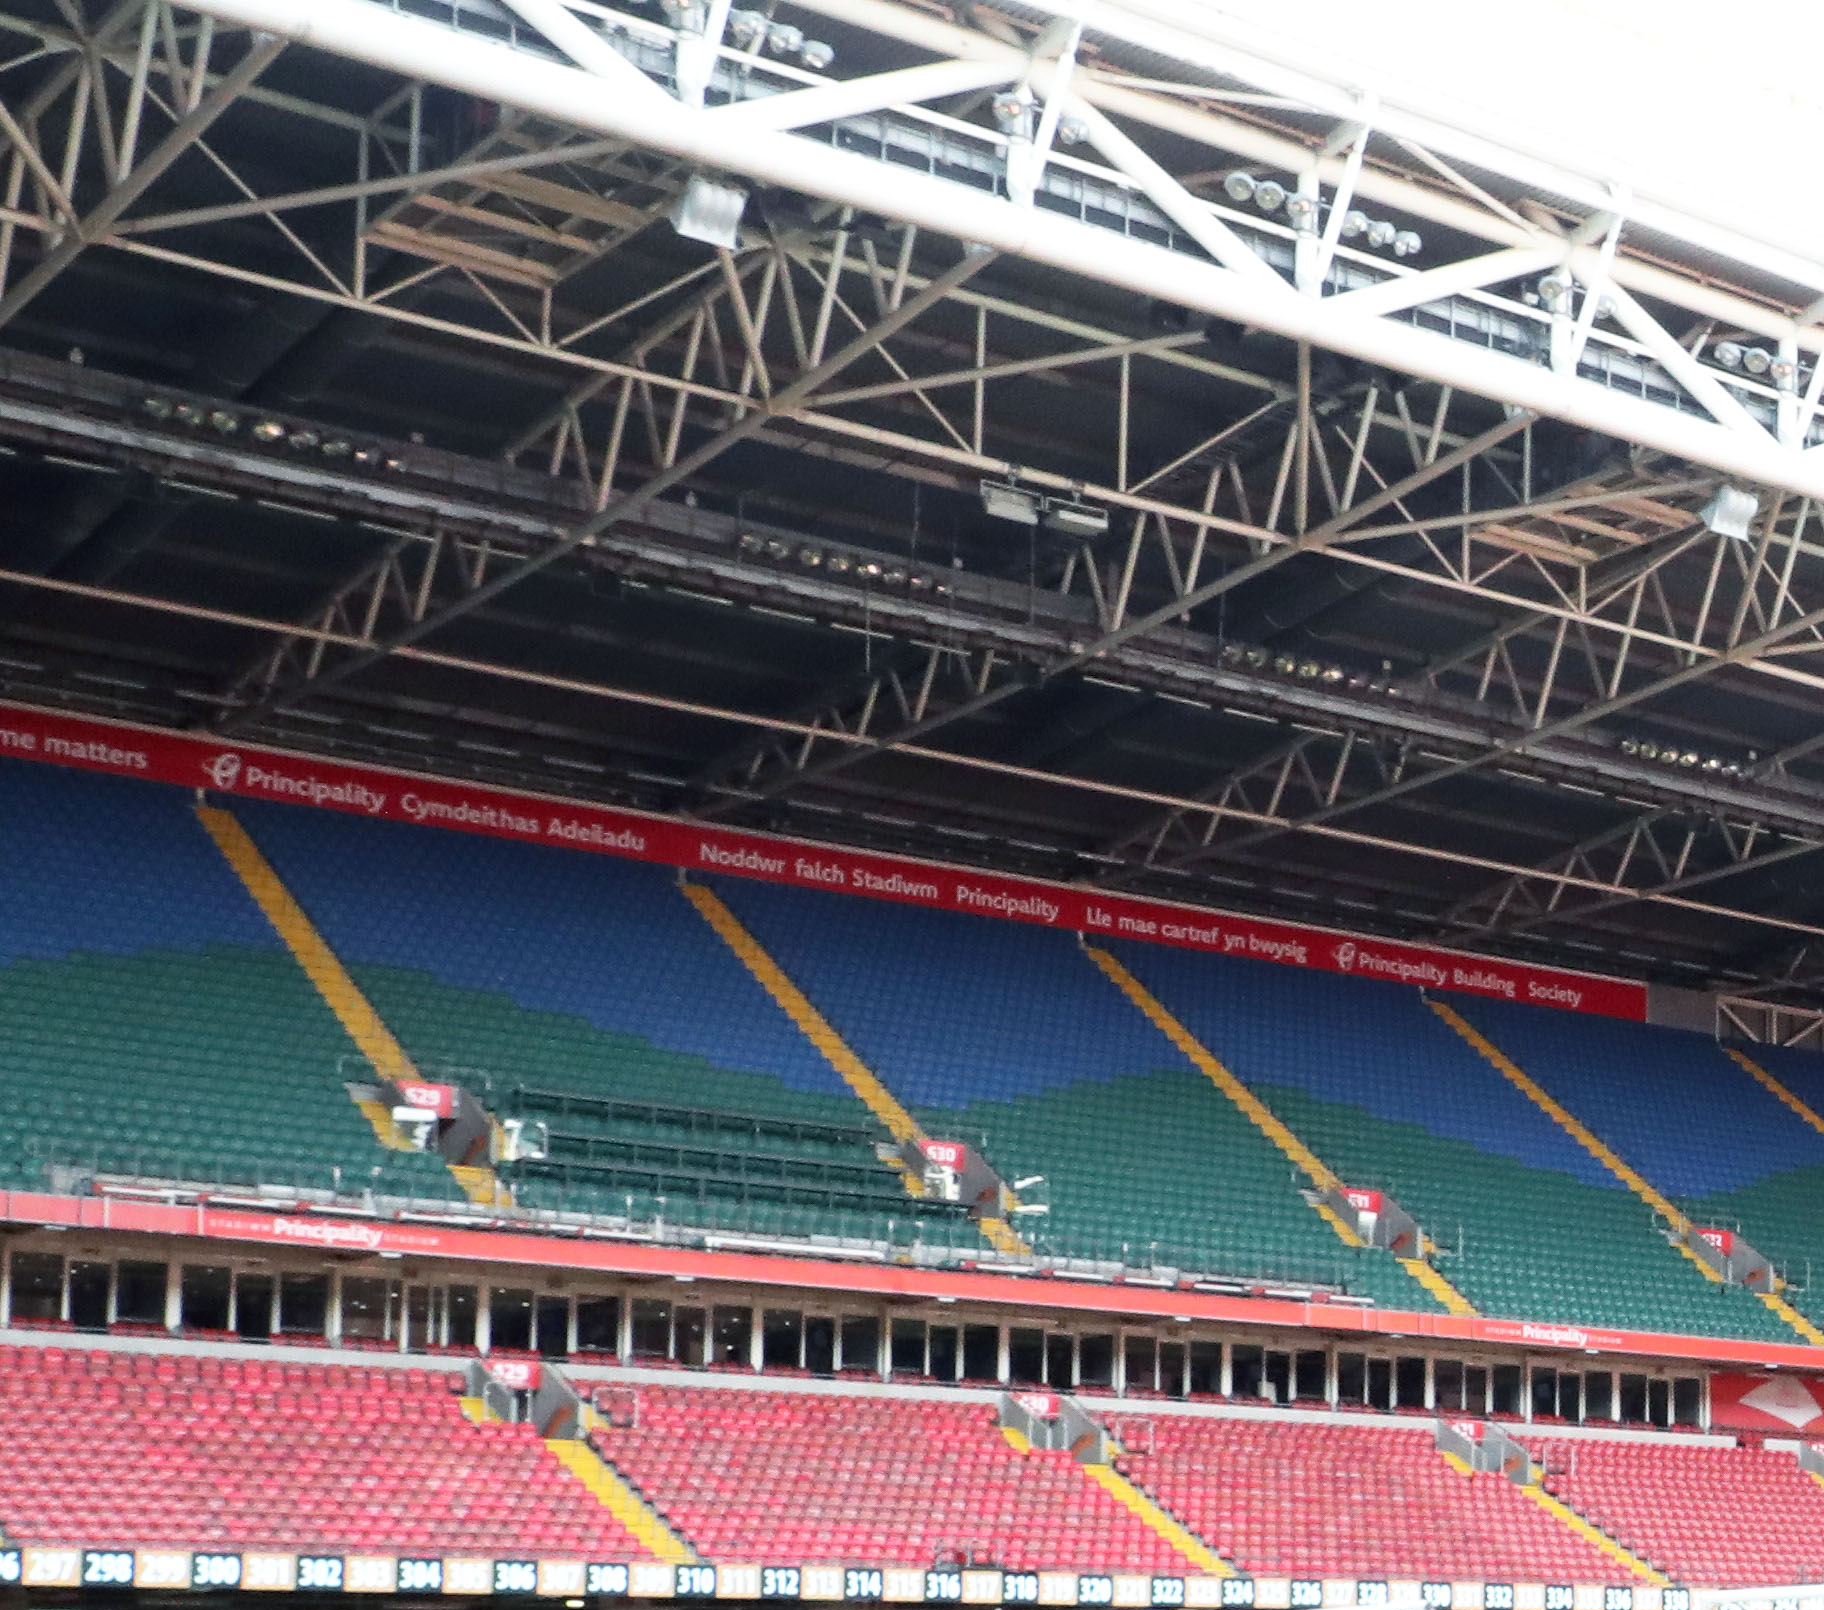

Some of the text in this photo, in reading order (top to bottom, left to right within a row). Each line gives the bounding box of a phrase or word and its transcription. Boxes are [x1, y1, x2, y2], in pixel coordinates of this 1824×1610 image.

[44, 736, 148, 769] matters
[246, 765, 647, 852] Principality Cymdeithas Adeiladu
[700, 844, 1060, 923] Noddwr falch Stadiwm Principality
[1086, 905, 1309, 965] Lle mae cartref yn bwysig
[1358, 952, 1583, 1008] Principality Building Society
[273, 1217, 384, 1249] Principality
[1522, 1324, 1588, 1347] Principality
[85, 1554, 132, 1582] 298
[194, 1556, 239, 1584] 300
[299, 1559, 341, 1586] 302
[399, 1561, 441, 1588] 304
[495, 1563, 535, 1589] 306
[588, 1566, 627, 1592] 308
[677, 1568, 714, 1593] 310
[722, 1569, 758, 1594] 311
[763, 1570, 798, 1595] 312
[806, 1571, 842, 1595] 313
[846, 1572, 881, 1596] 314
[927, 1574, 960, 1598] 316
[1004, 1576, 1038, 1600] 318
[1079, 1578, 1112, 1602] 320
[1152, 1580, 1183, 1603] 322
[1223, 1581, 1253, 1604] 324
[1291, 1582, 1320, 1605] 326
